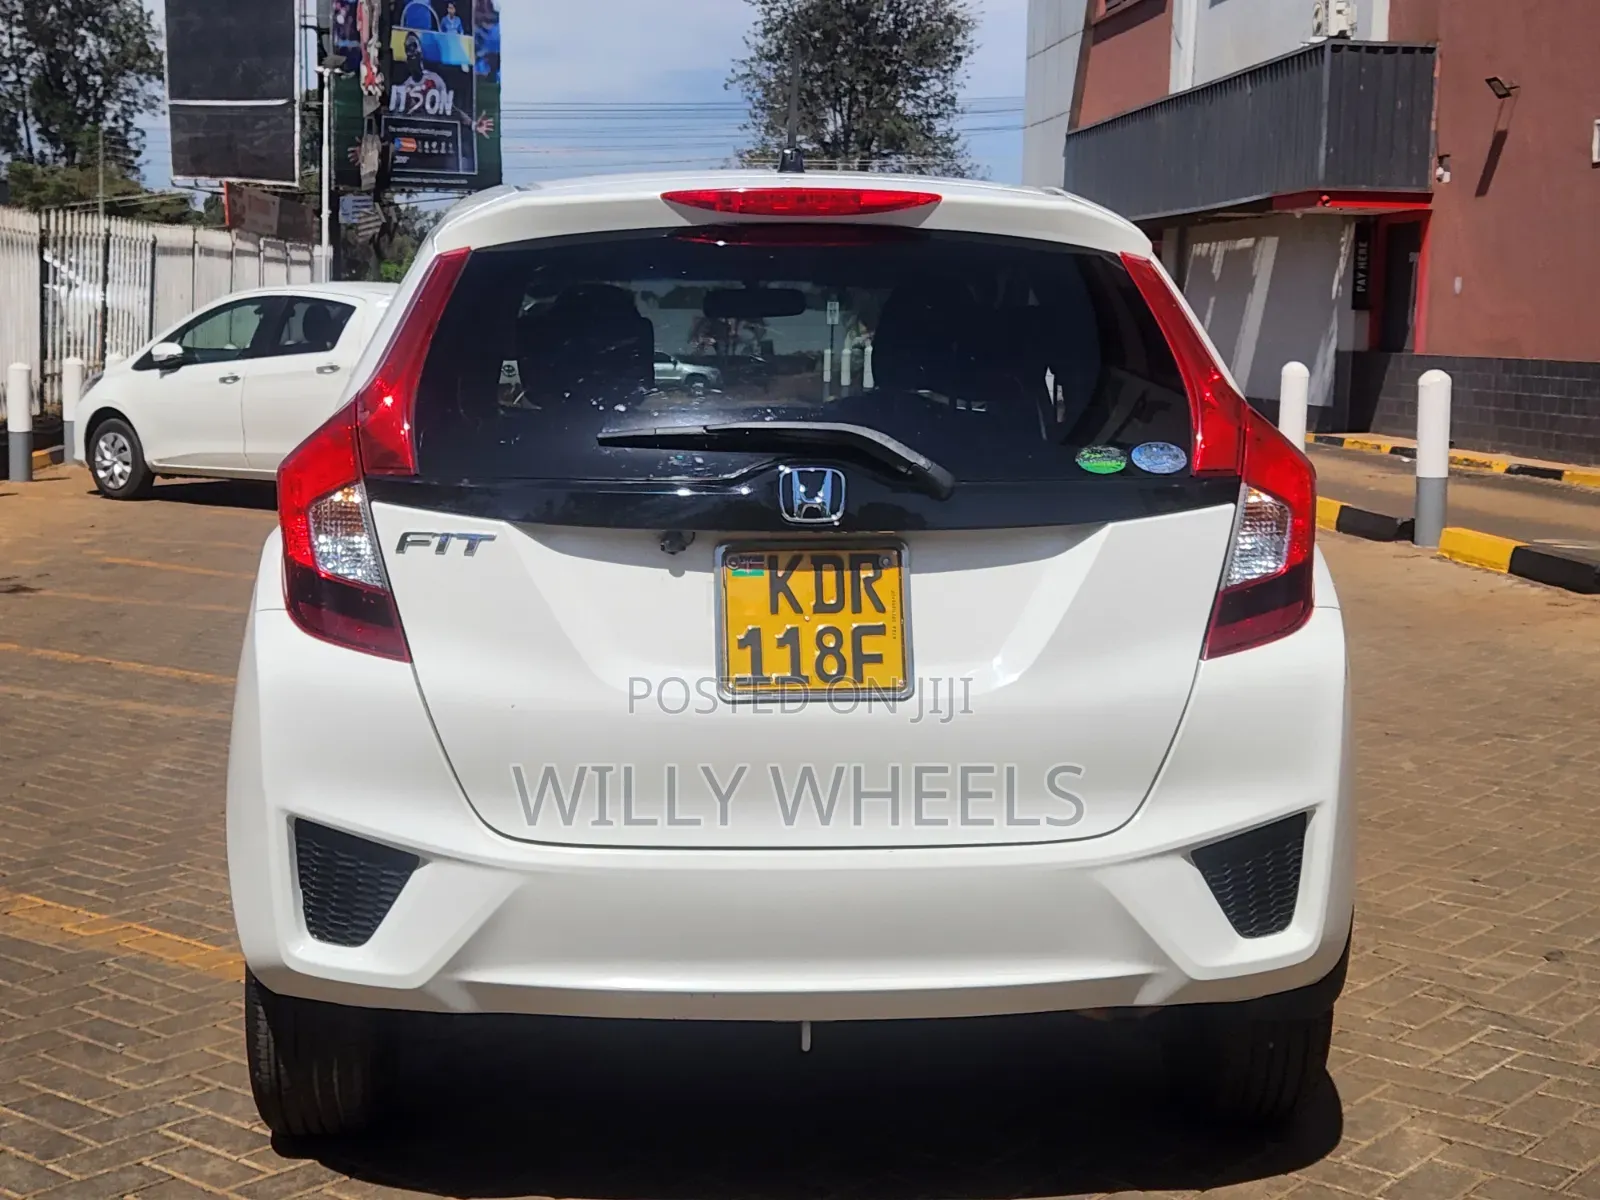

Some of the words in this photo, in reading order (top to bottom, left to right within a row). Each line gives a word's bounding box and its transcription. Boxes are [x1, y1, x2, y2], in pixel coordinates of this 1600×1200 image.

[425, 88, 454, 116] ON
[1358, 241, 1369, 269] HERE
[1356, 272, 1367, 292] PAY
[395, 531, 498, 557] FIT
[767, 553, 887, 616] KDR
[734, 623, 887, 687] 118F
